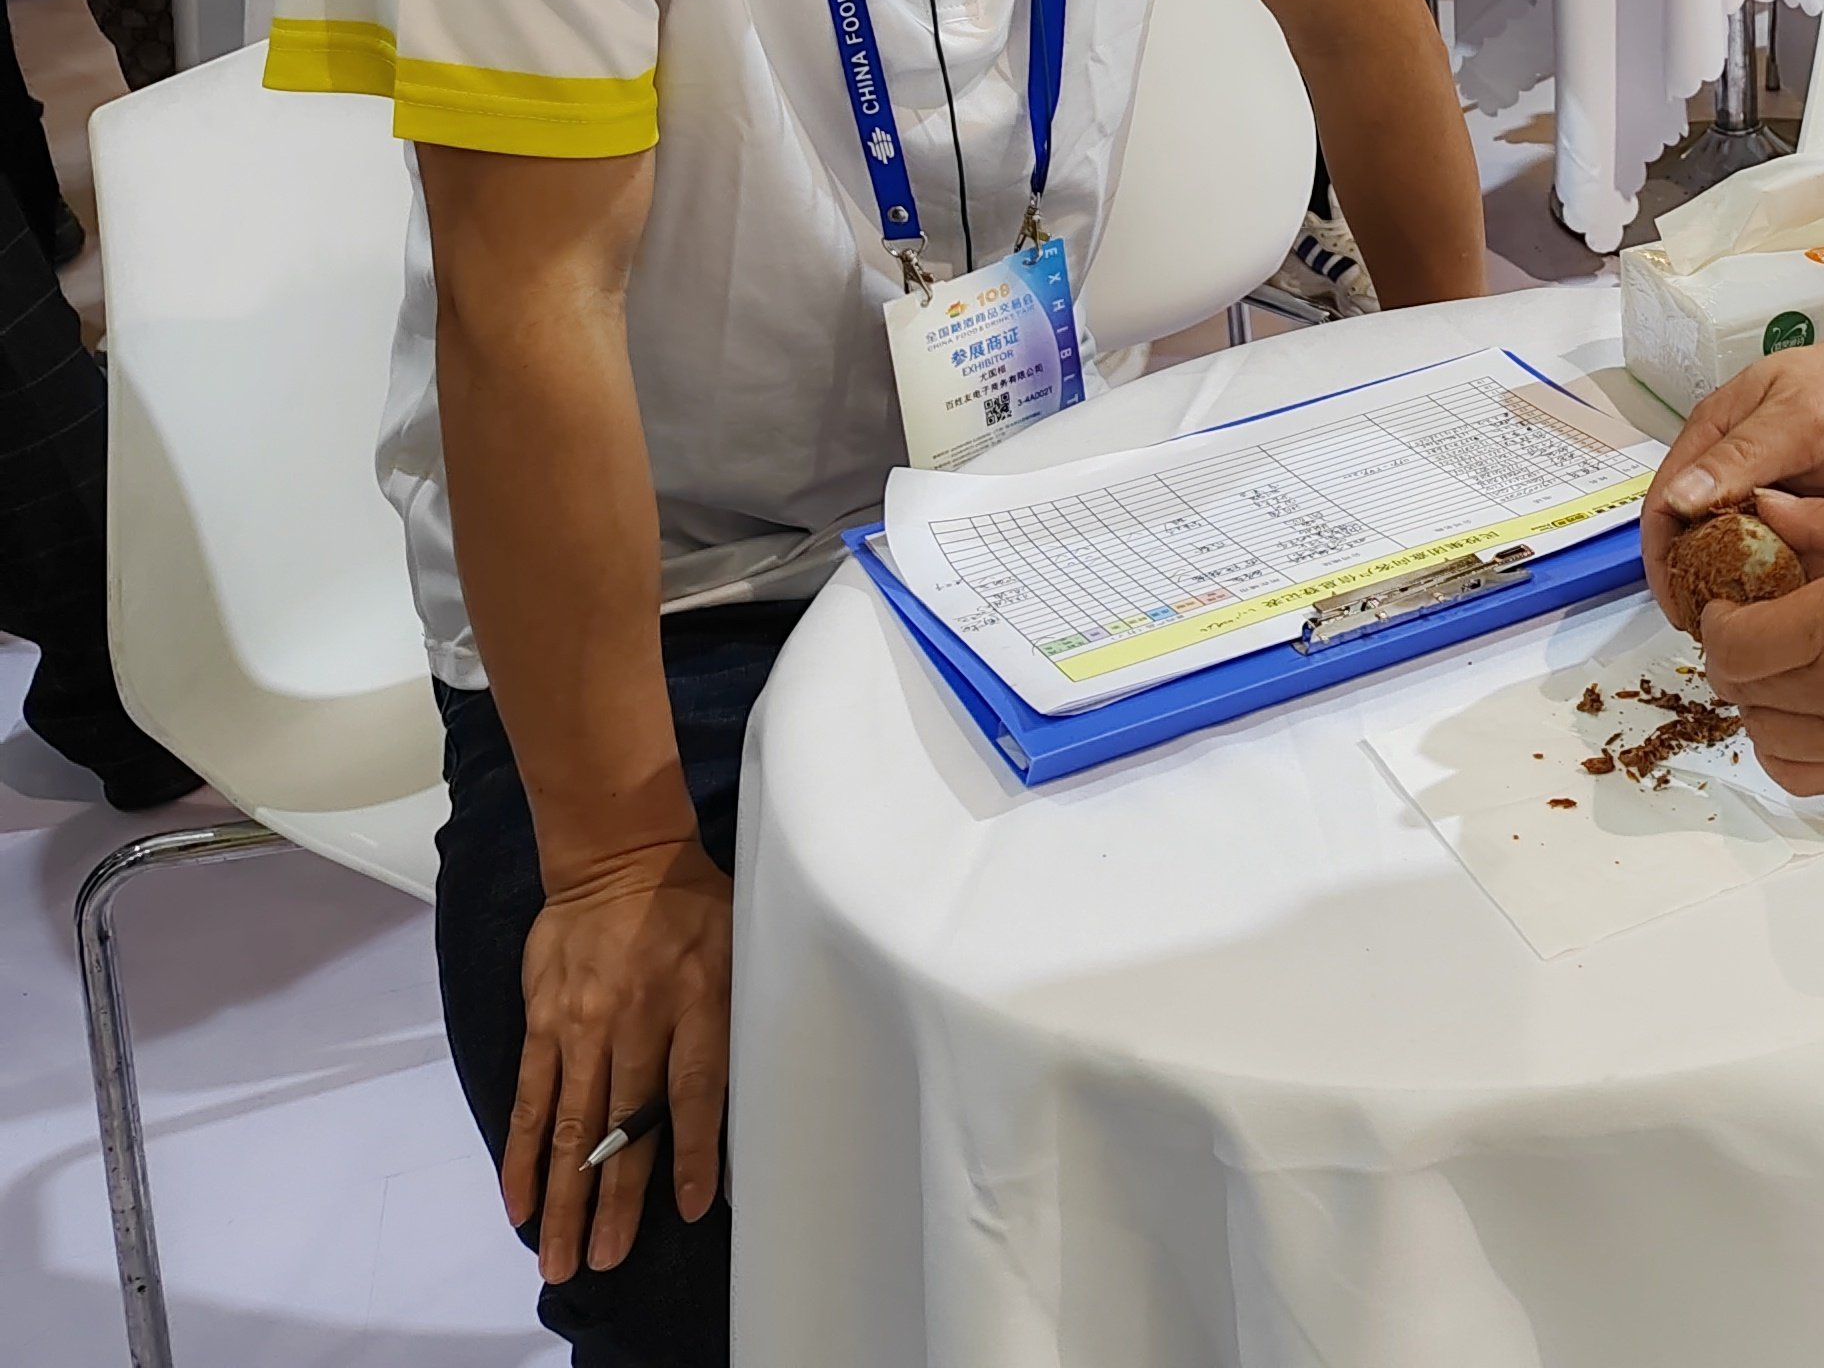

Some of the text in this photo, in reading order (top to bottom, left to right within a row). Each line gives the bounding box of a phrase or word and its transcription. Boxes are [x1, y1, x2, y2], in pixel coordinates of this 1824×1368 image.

[850, 50, 881, 116] CHINA
[976, 283, 1010, 307] 108
[951, 326, 1020, 368] 参展商证
[962, 349, 1015, 377] EXHIBITOR
